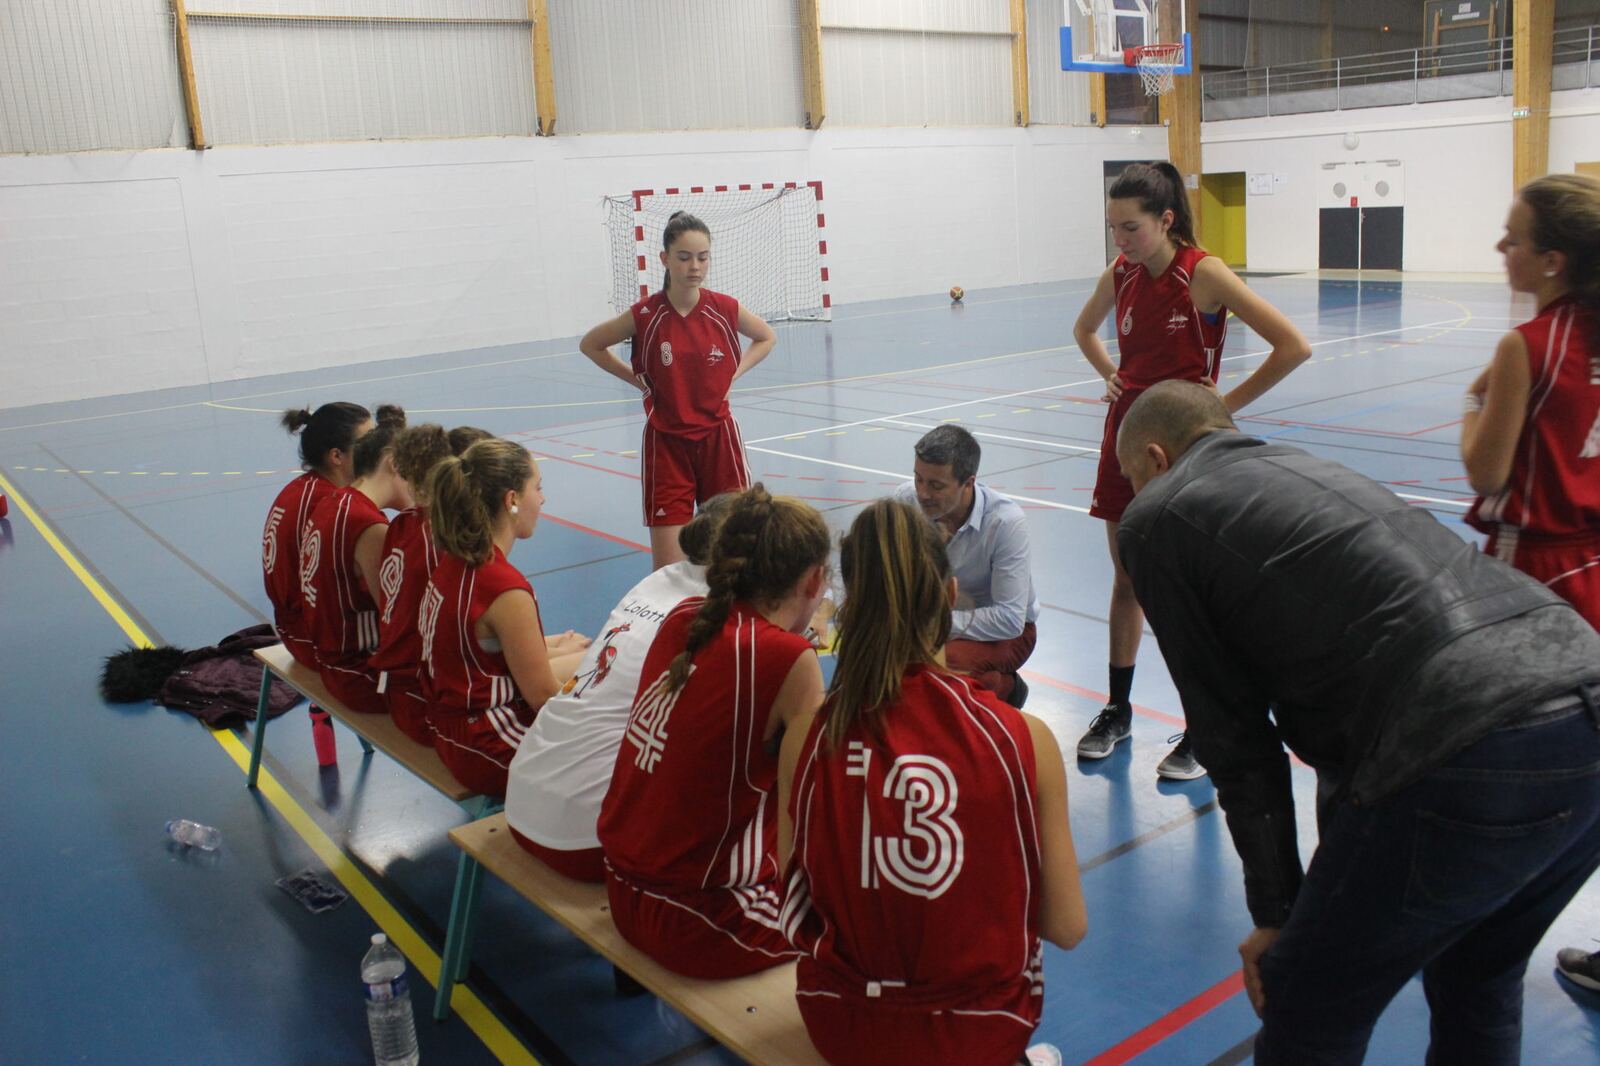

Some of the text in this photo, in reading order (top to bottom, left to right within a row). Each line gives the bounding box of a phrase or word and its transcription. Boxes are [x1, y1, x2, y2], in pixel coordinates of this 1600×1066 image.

[660, 341, 673, 366] 8
[1120, 306, 1133, 336] 6
[626, 664, 698, 774] 4
[846, 741, 964, 900] 13
